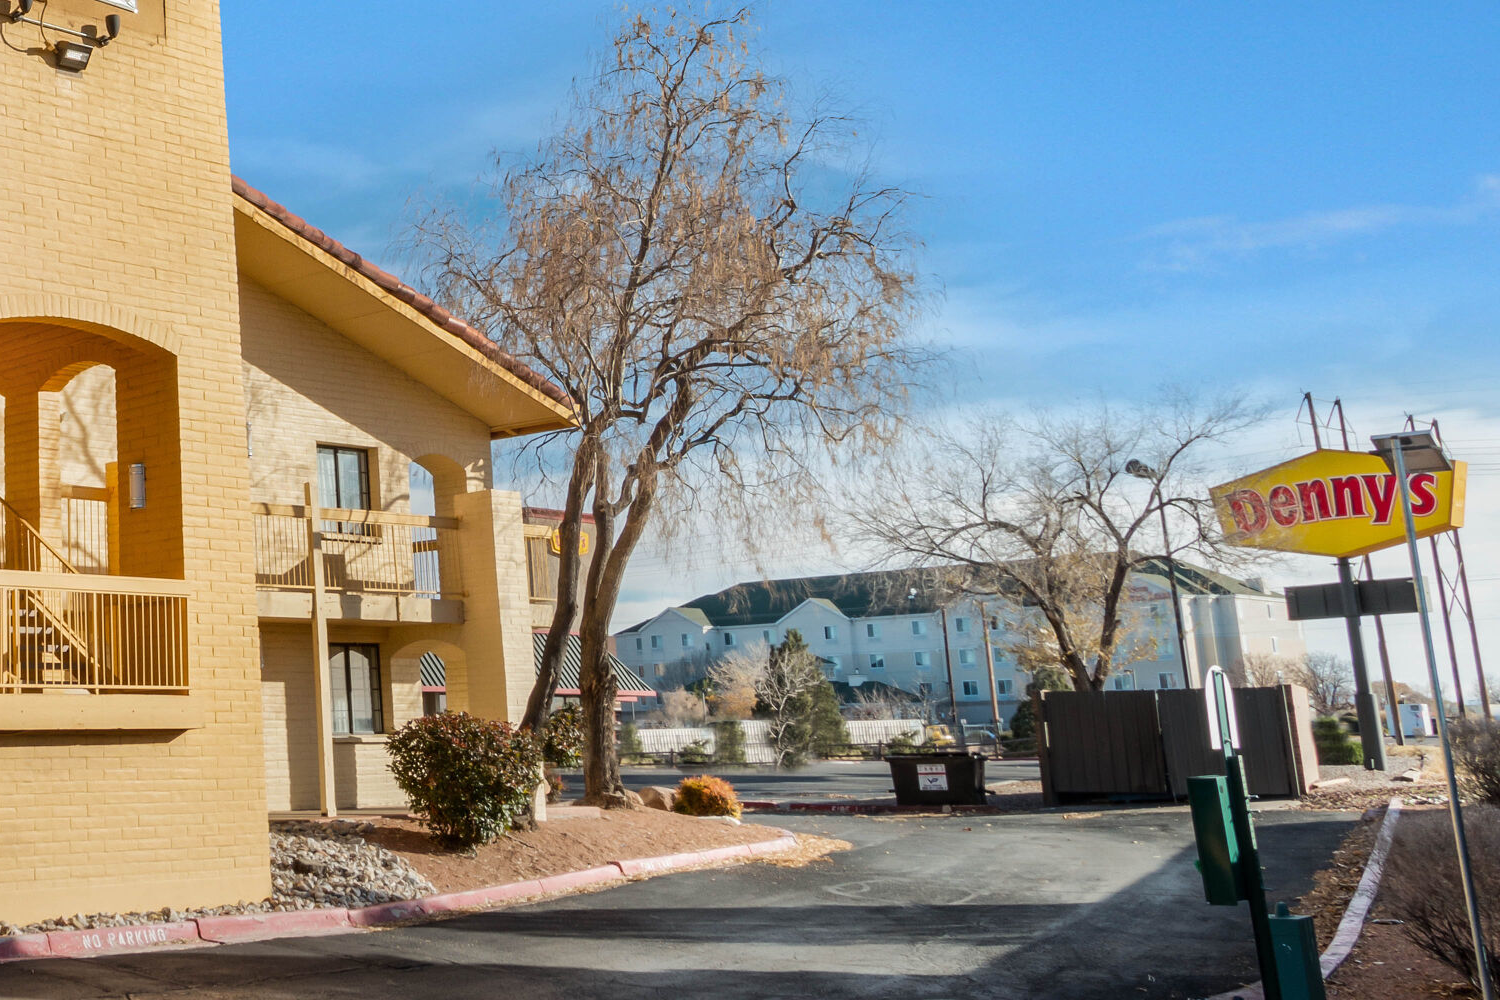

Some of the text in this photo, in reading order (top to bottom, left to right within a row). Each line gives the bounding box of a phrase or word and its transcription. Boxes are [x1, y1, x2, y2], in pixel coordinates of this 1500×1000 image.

[1224, 472, 1438, 536] Dennys
[82, 928, 167, 949] NO PARKING
